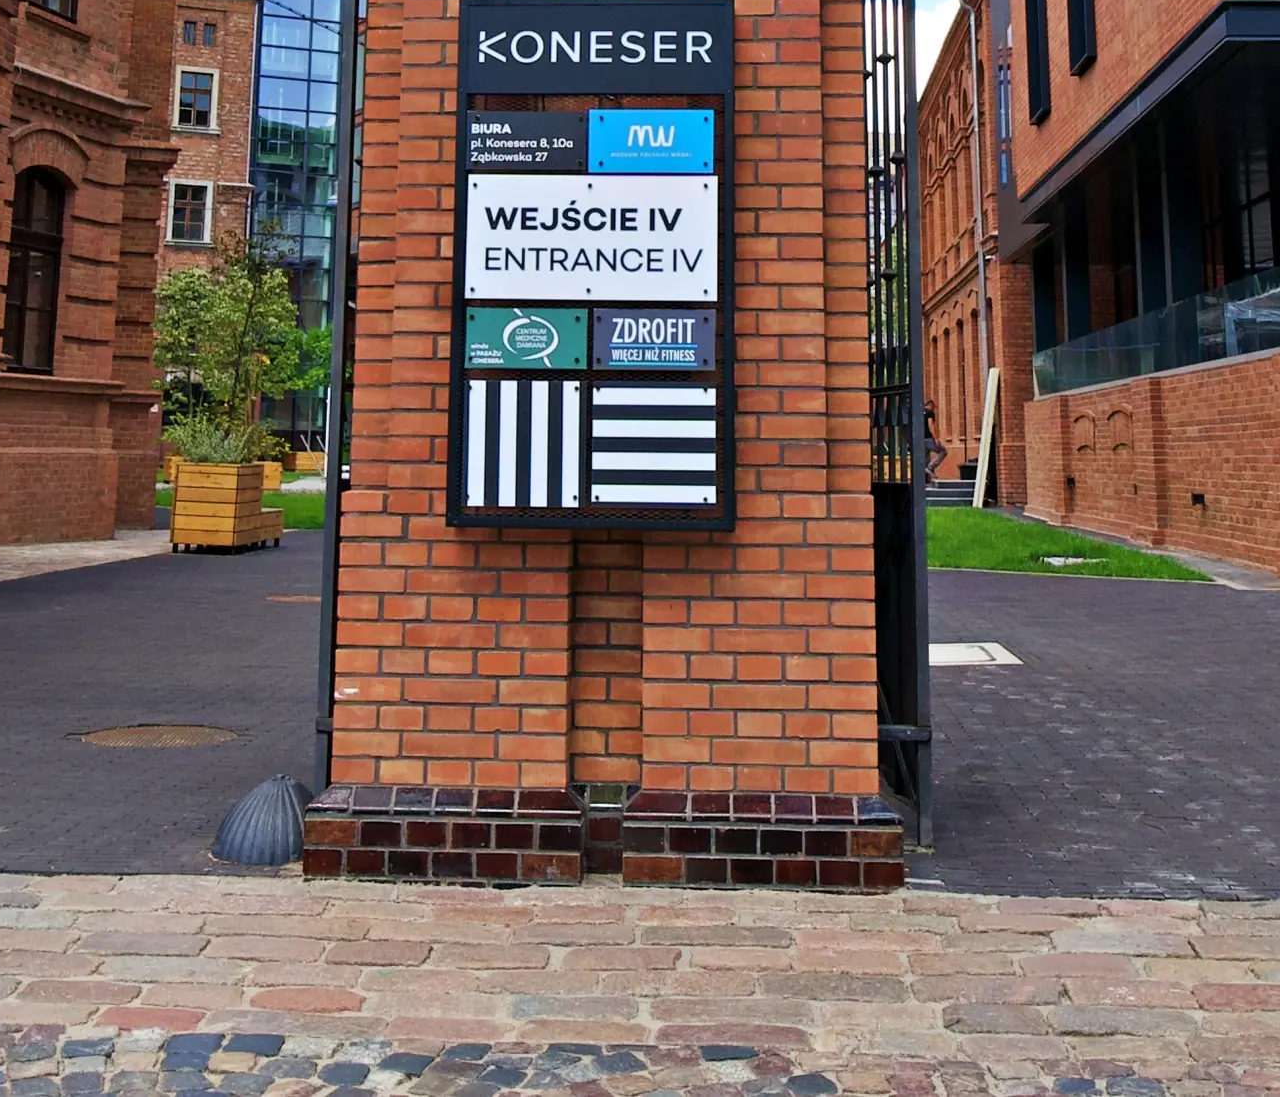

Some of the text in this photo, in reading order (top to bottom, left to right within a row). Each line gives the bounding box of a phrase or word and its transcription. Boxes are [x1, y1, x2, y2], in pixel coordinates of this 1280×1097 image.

[478, 30, 713, 64] KONESER
[471, 123, 512, 135] BIURA
[470, 137, 574, 150] pl. Konesera 8, 10a
[470, 152, 548, 163] Ząbkowska 27
[484, 200, 683, 232] WEJŚCIE IV
[484, 248, 704, 272] ENTRANCE IV
[612, 318, 696, 343] ZDROFIT
[612, 347, 696, 362] WIĘCEJ NIŻ FITNESS
